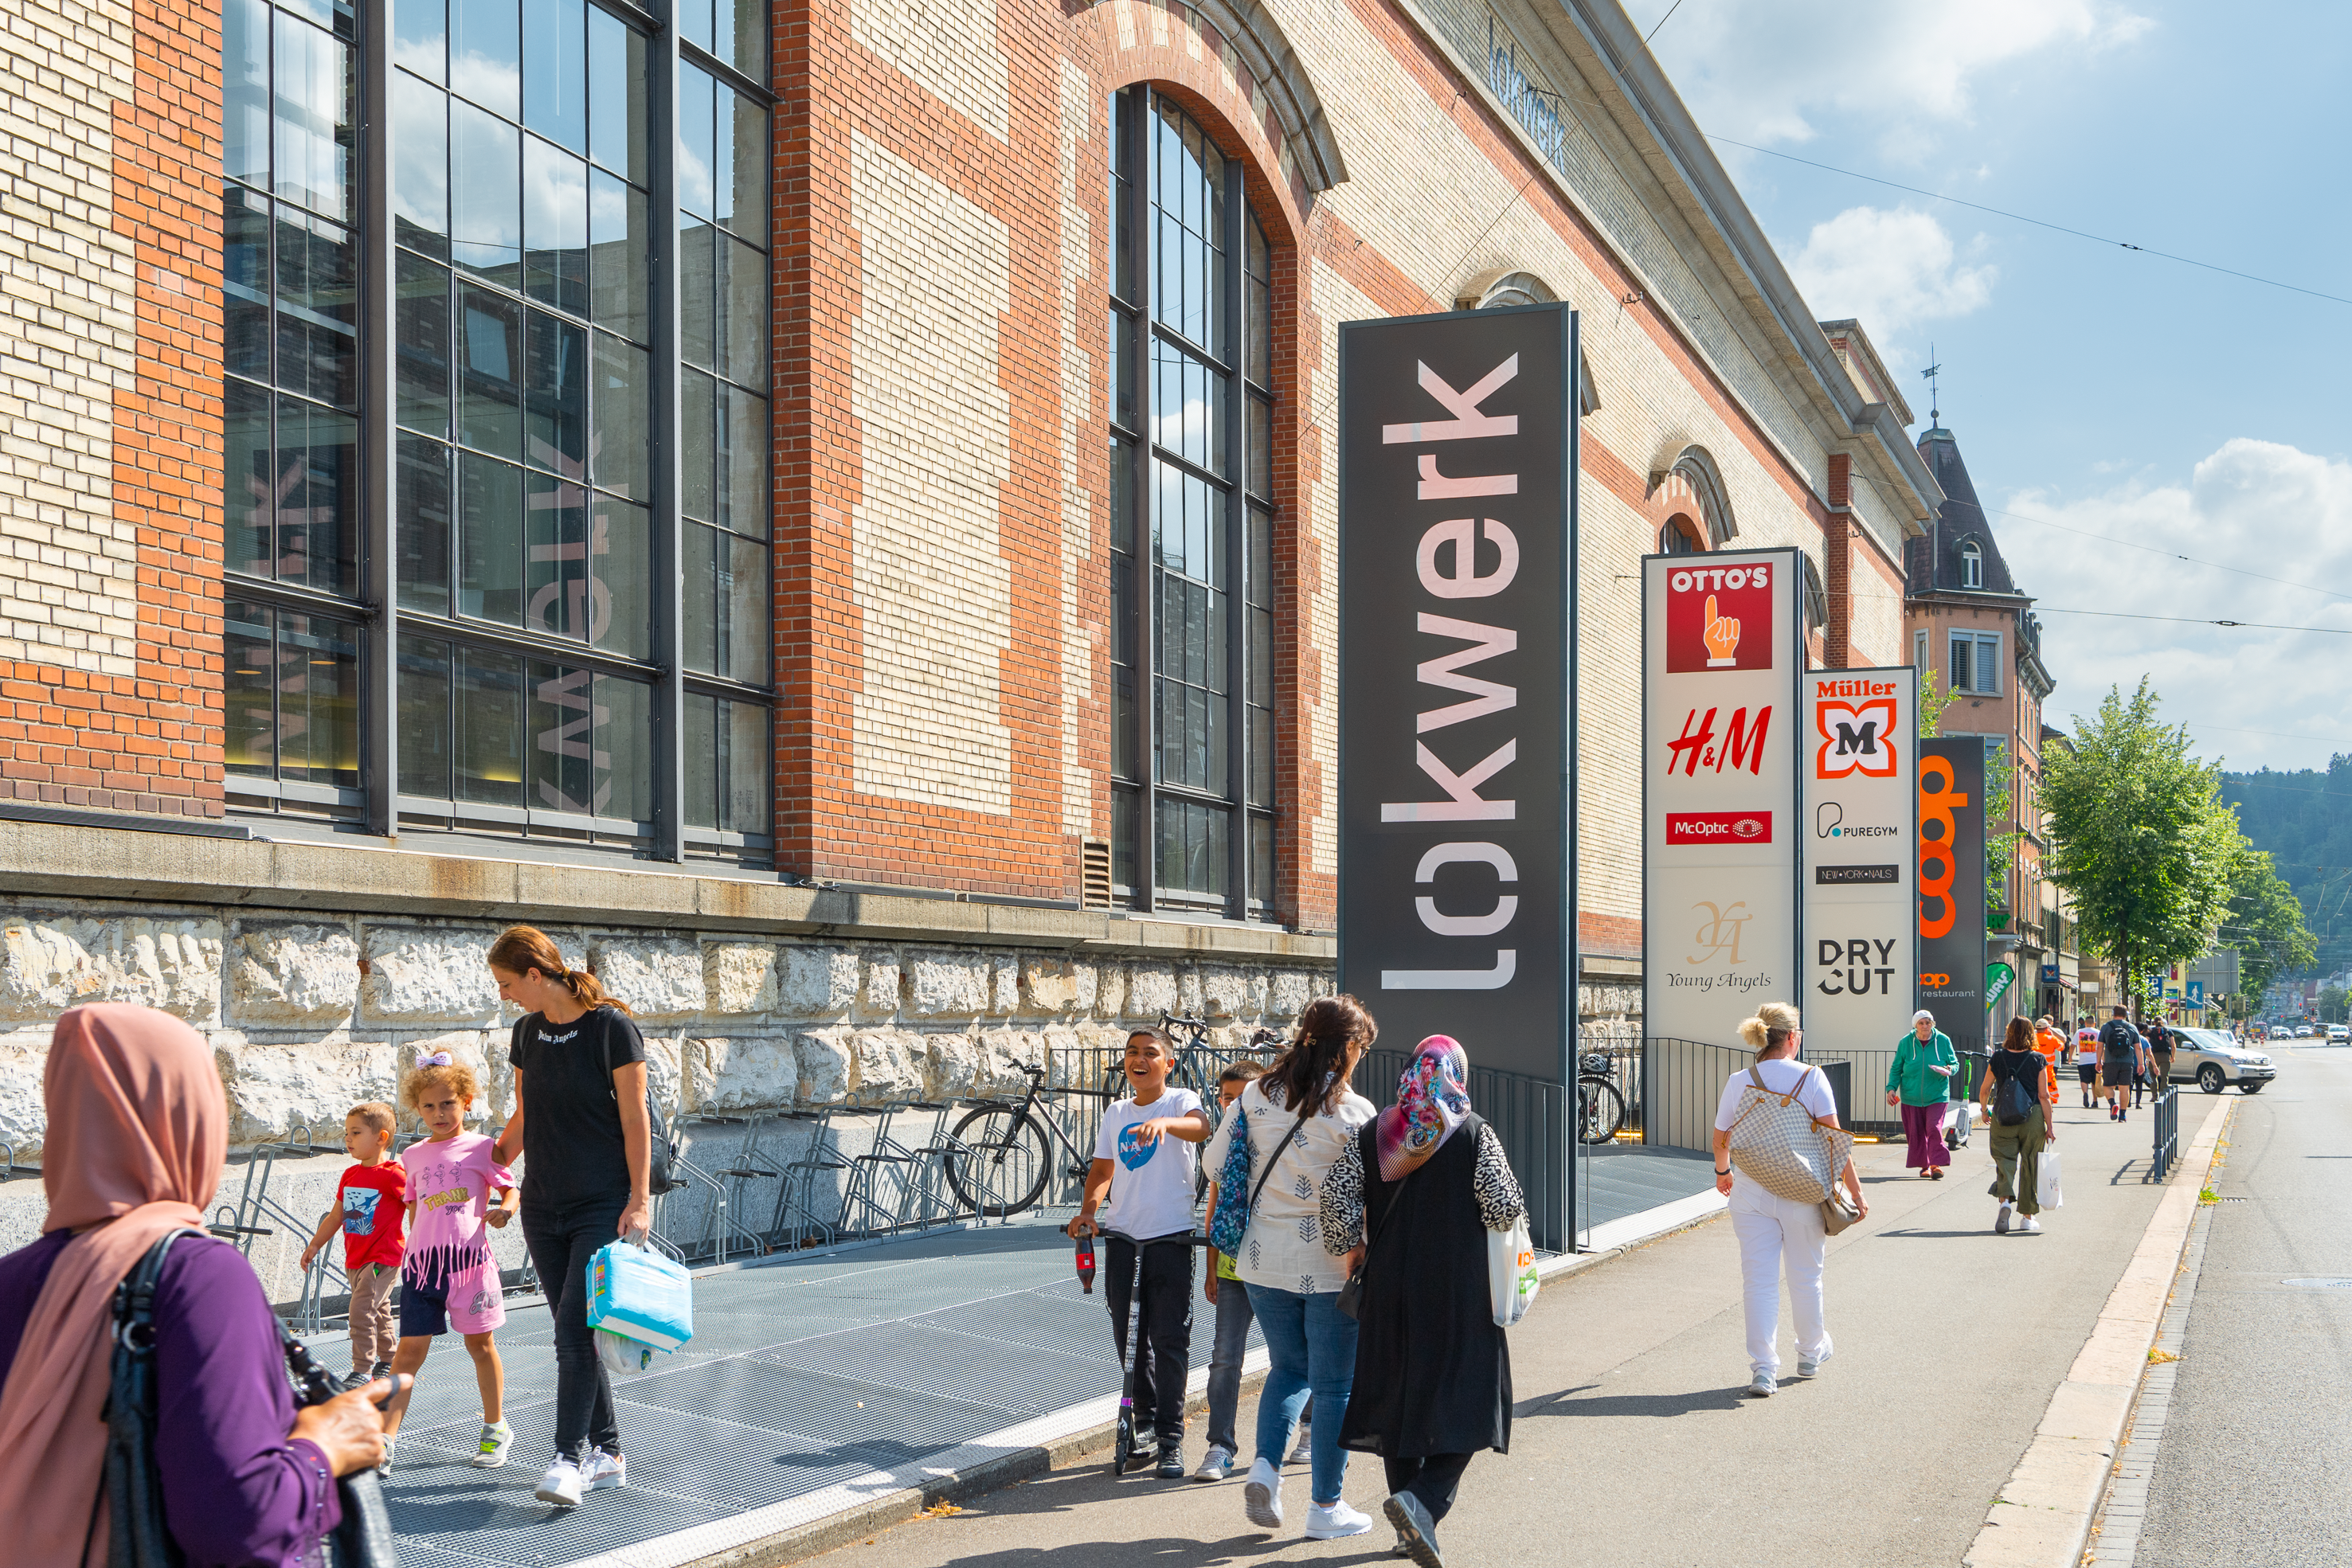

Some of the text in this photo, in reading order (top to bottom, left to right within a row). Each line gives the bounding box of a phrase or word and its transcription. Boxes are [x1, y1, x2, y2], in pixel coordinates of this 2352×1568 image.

[1671, 566, 1768, 592] OTTO'S
[1816, 679, 1896, 698] Müller
[1666, 705, 1772, 777] H&M
[1835, 721, 1877, 756] M
[1674, 820, 1729, 836] McOptic
[1843, 826, 1898, 838] PUREGYM
[1822, 870, 1838, 879] NEW
[1842, 870, 1865, 879] YORK
[1818, 938, 1896, 967] DRY
[1665, 972, 1771, 993] Young Angels
[1817, 968, 1896, 995] CUT
[1986, 970, 2010, 1010] WAY
[1922, 989, 1975, 998] restaurant
[538, 1029, 578, 1044] Palm Angels
[424, 1187, 470, 1211] THANK
